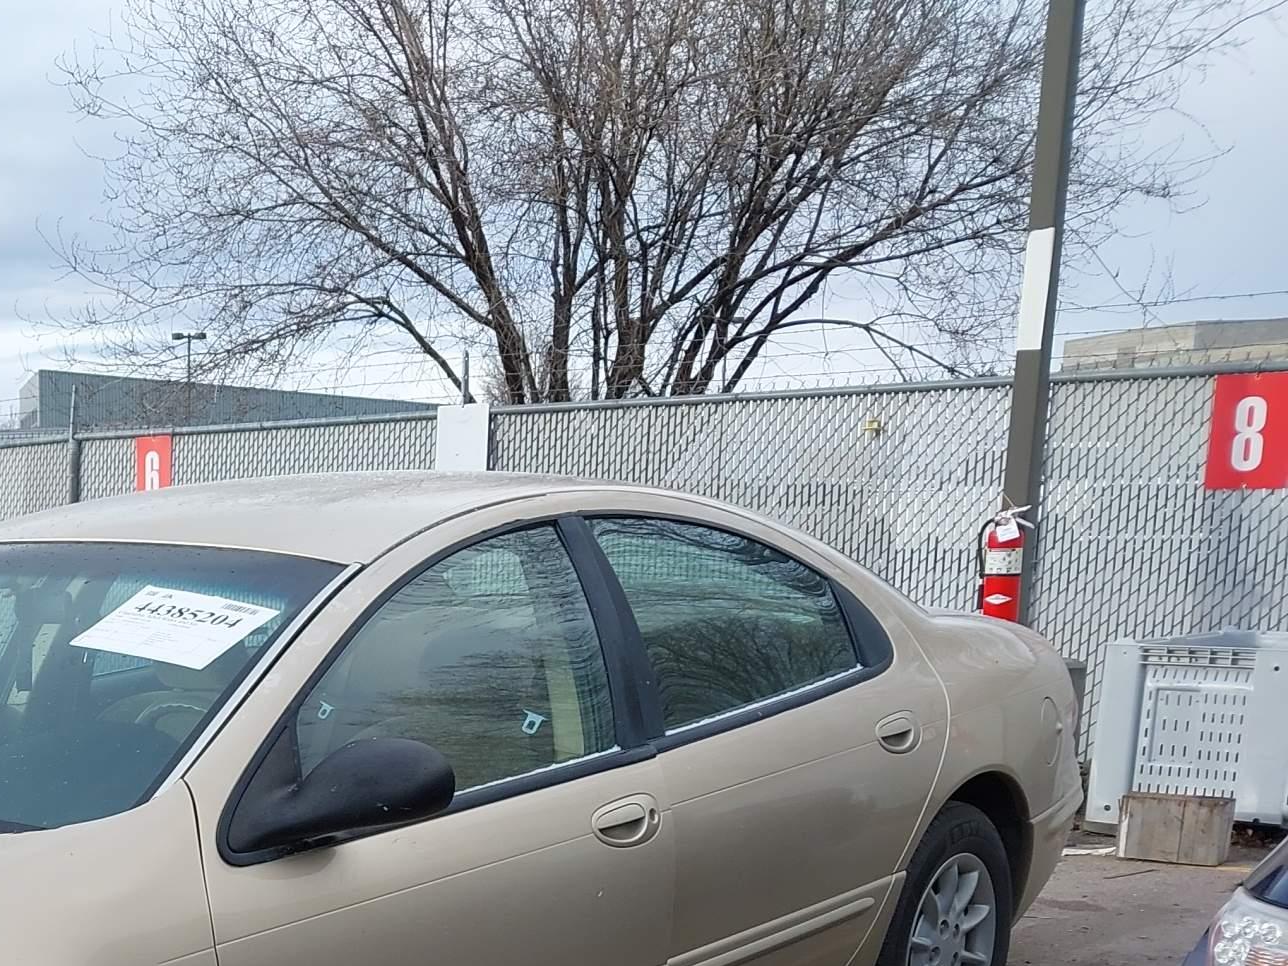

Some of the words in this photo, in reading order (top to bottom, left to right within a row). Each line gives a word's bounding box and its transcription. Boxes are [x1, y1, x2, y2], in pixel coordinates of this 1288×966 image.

[1230, 395, 1268, 473] 8
[144, 450, 160, 490] 6
[134, 600, 243, 629] 44385204
